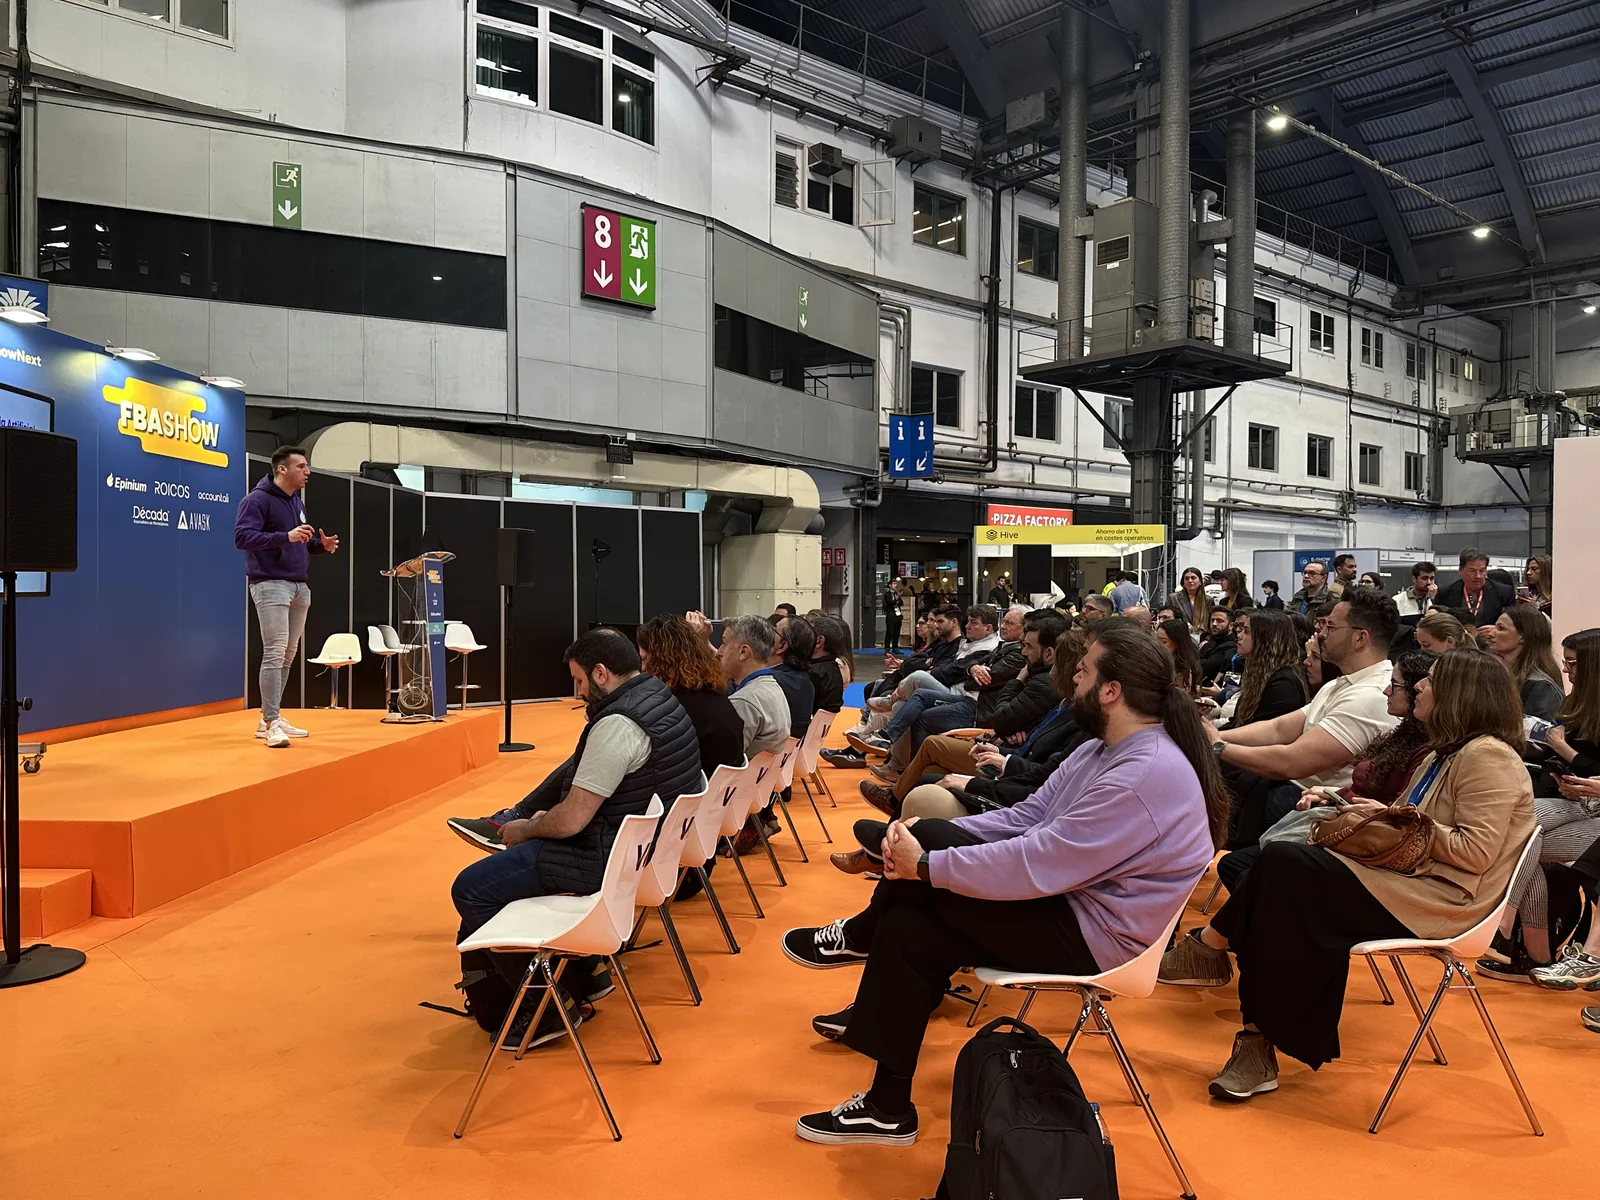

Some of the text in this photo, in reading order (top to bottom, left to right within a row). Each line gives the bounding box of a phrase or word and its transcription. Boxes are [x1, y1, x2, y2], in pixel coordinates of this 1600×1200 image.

[594, 214, 612, 249] 8
[114, 476, 147, 492] Epinium
[154, 480, 190, 499] ROICOS
[132, 505, 169, 522] Década
[189, 512, 211, 532] AVASK
[1000, 531, 1019, 539] Hive
